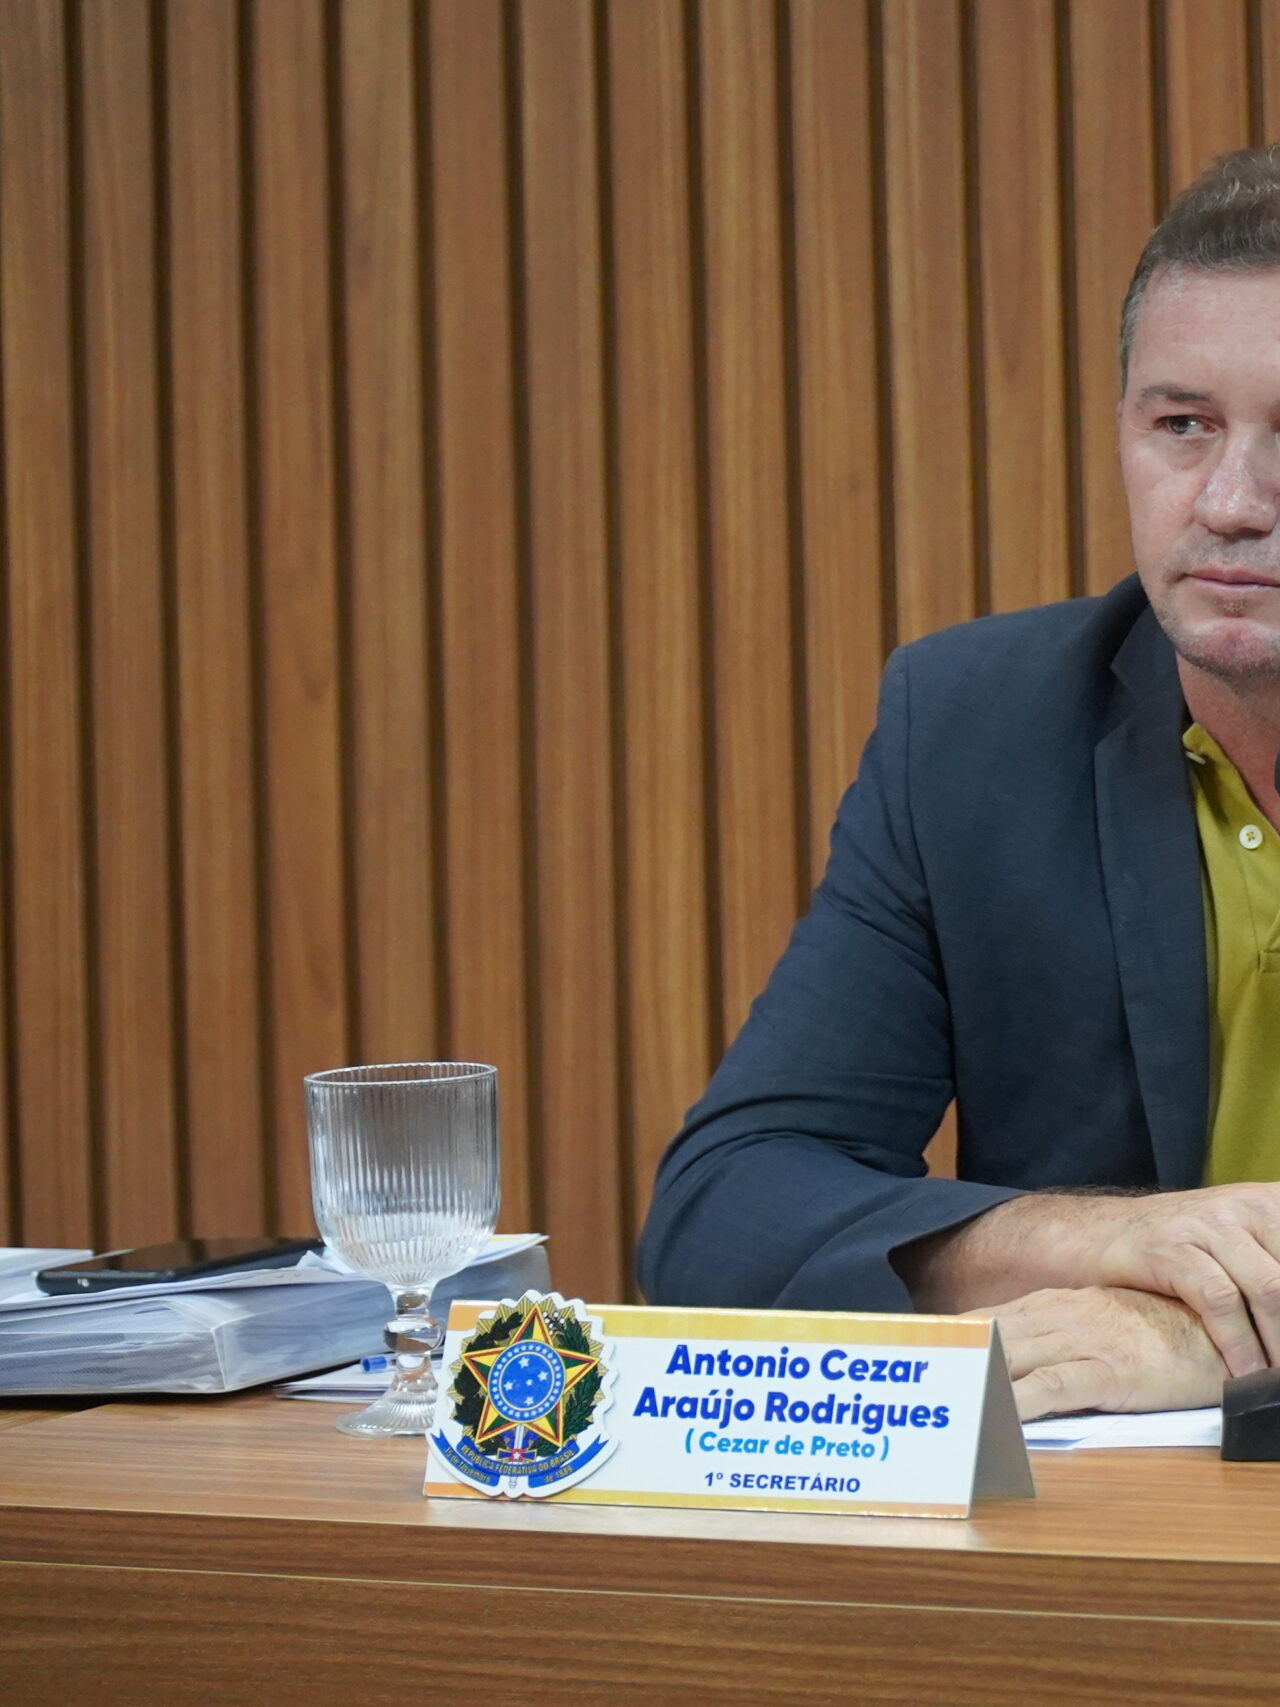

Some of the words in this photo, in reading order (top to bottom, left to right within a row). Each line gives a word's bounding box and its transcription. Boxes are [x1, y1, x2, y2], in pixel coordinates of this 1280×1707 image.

[665, 1344, 810, 1380] Antonio
[819, 1348, 929, 1384] Cezar
[632, 1386, 756, 1430] Araújo
[763, 1391, 951, 1436] Rodrigues
[774, 1434, 805, 1456] de
[729, 1472, 862, 1494] SECRETÁRIO
